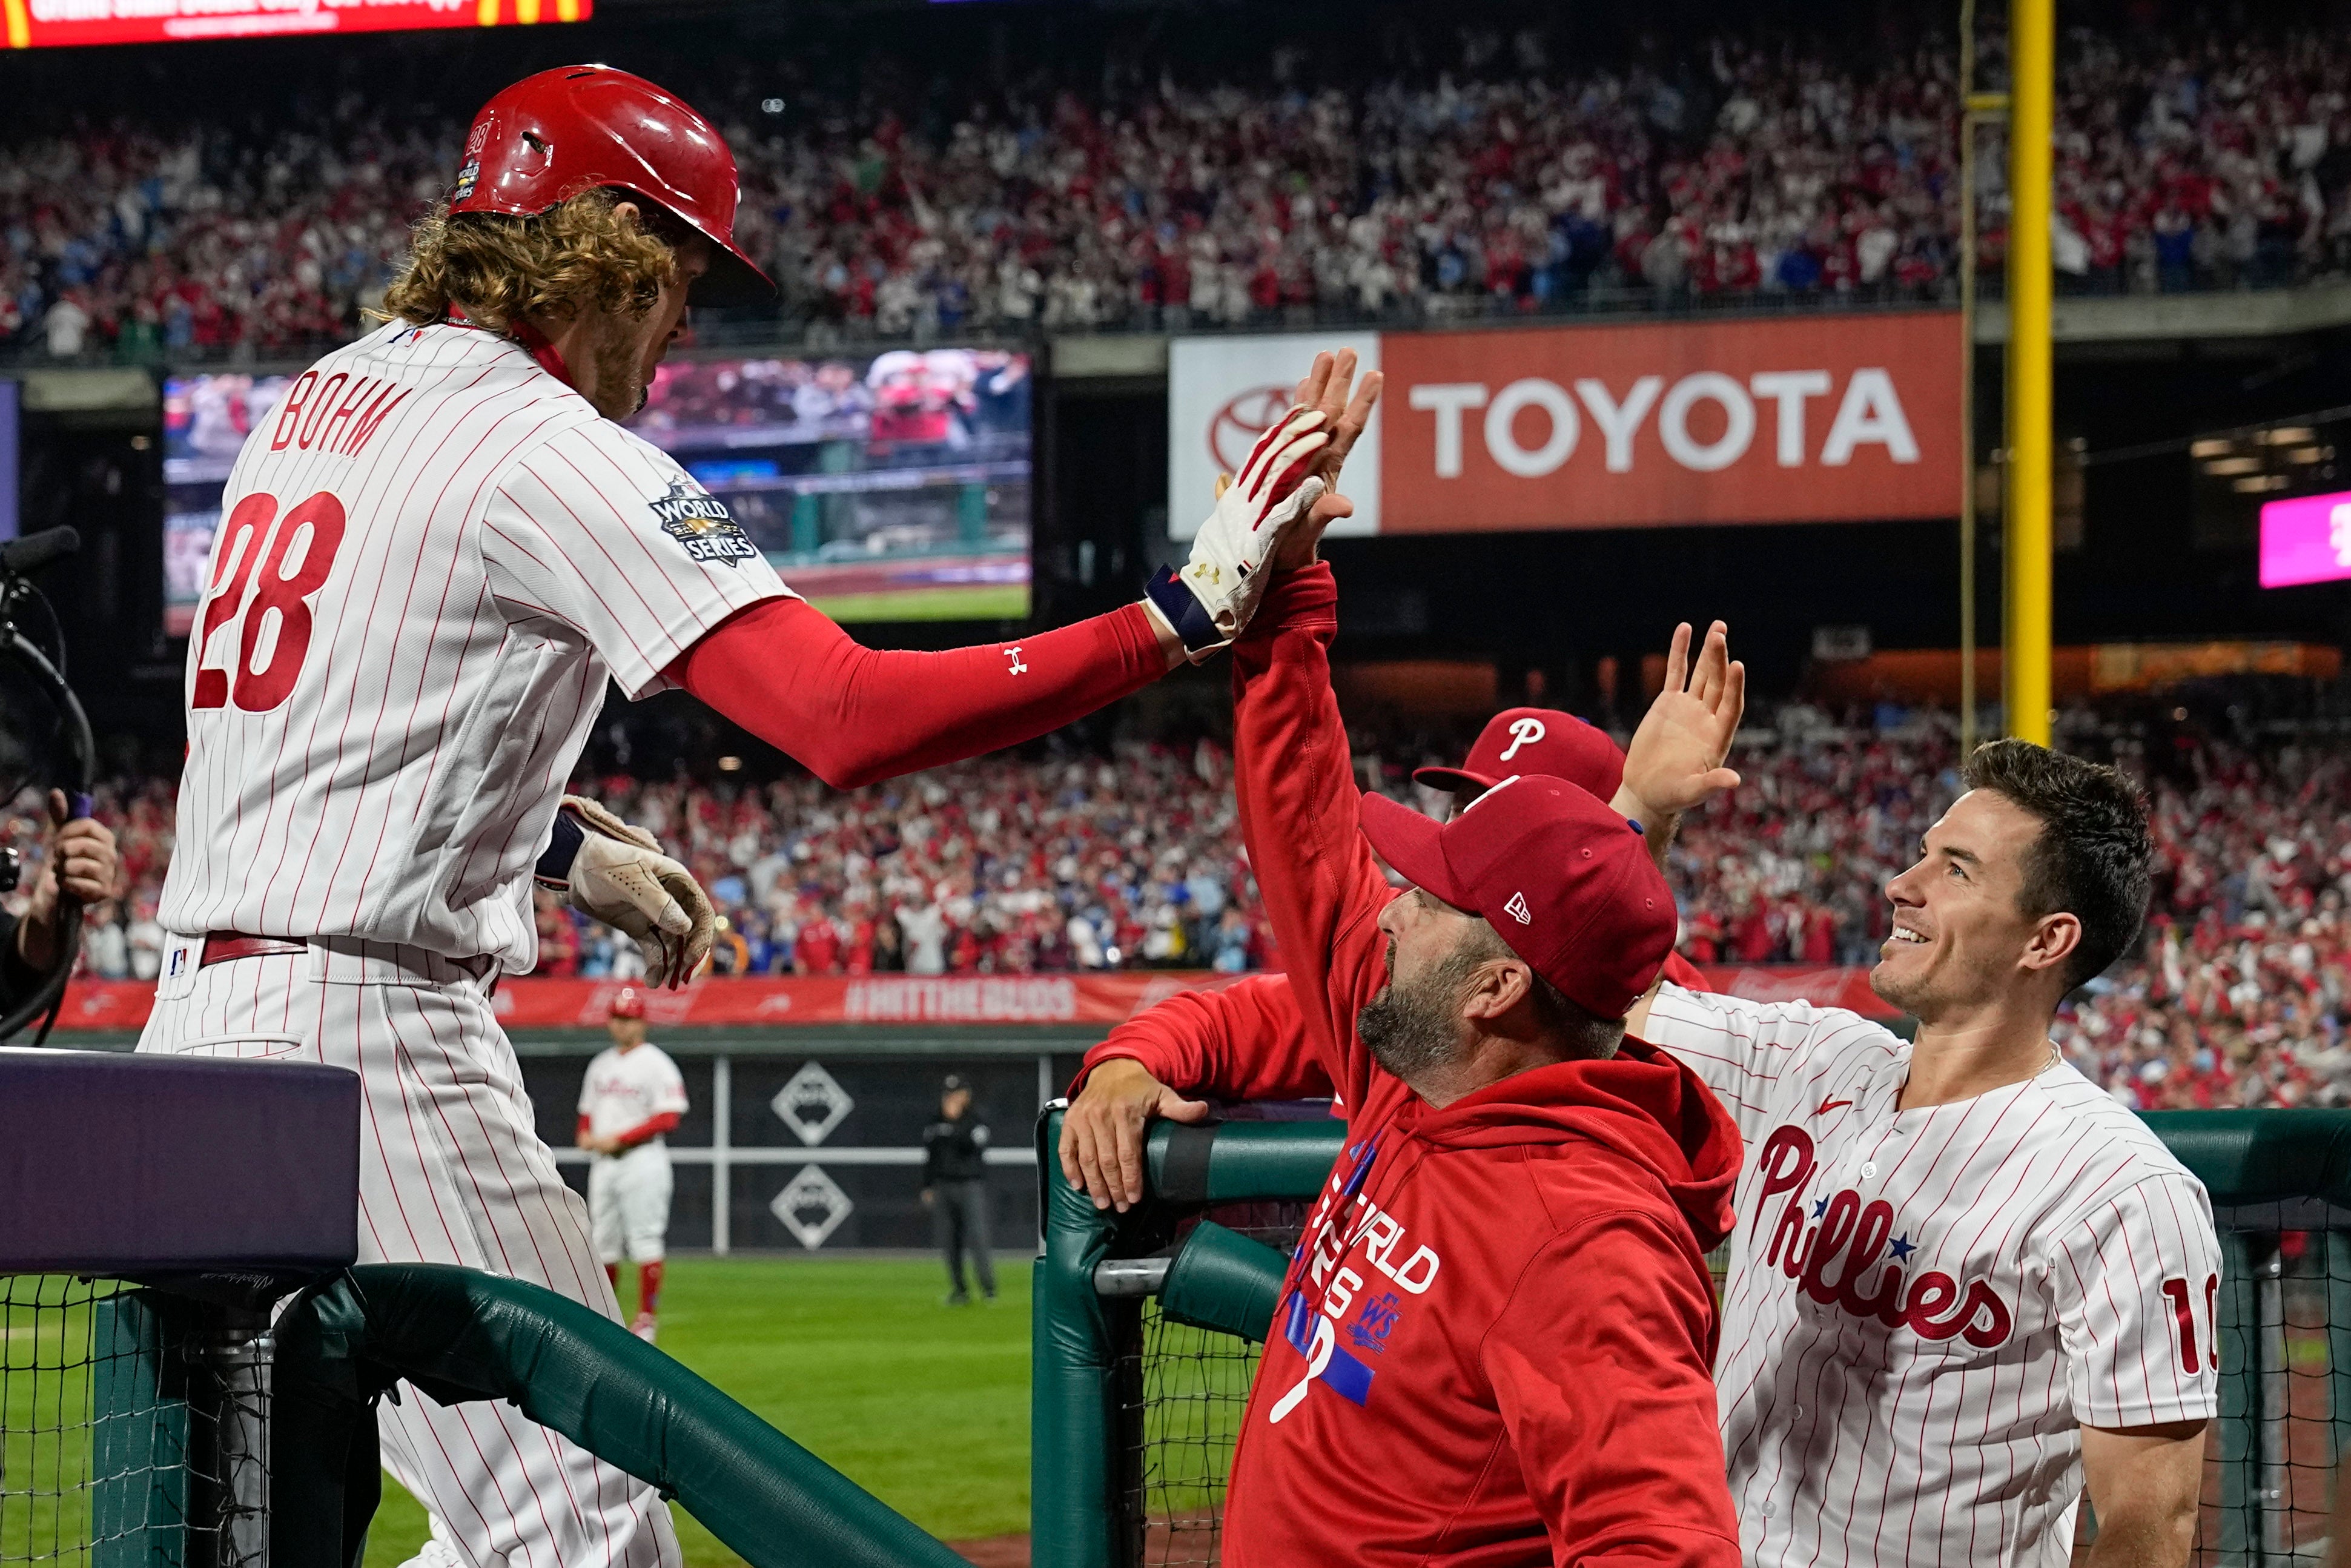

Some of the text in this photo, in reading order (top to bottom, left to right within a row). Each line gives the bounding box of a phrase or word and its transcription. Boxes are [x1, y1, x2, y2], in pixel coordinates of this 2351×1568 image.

[270, 370, 415, 460] BOHM
[1409, 367, 1922, 478] TOYOTA
[652, 500, 730, 523] WORLD
[686, 537, 756, 560] SERIES
[191, 490, 349, 715] 28
[1500, 718, 1546, 761] P
[1751, 1124, 2012, 1348] Phillies
